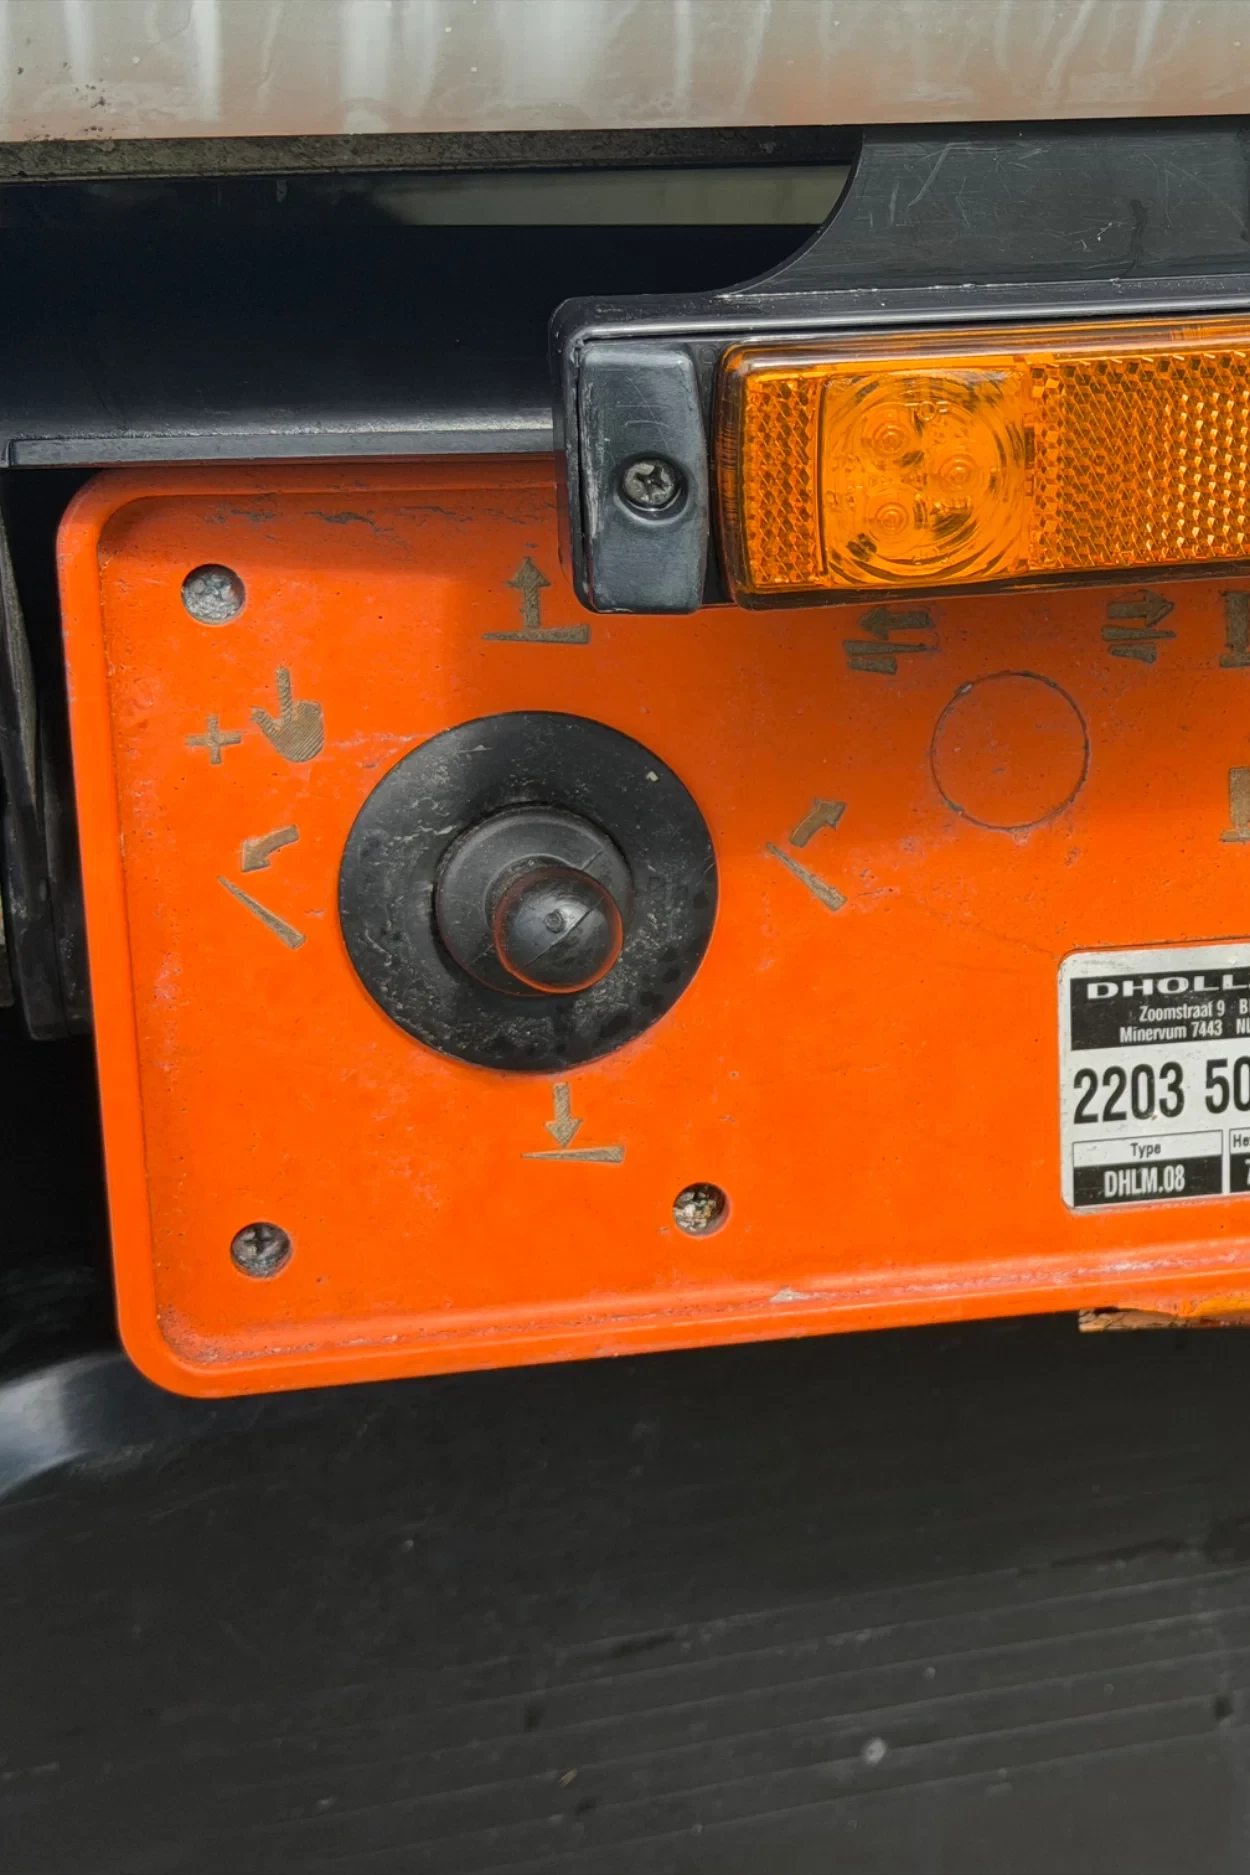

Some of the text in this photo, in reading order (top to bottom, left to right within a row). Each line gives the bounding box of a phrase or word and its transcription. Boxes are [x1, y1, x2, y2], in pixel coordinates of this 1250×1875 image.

[1216, 1000, 1226, 1017] 9
[1120, 1024, 1188, 1043] Minervum
[1191, 1019, 1224, 1038] 7443
[1073, 1061, 1185, 1124] 2203
[1130, 1142, 1162, 1157] Type
[1103, 1164, 1186, 1198] DHLM.08
